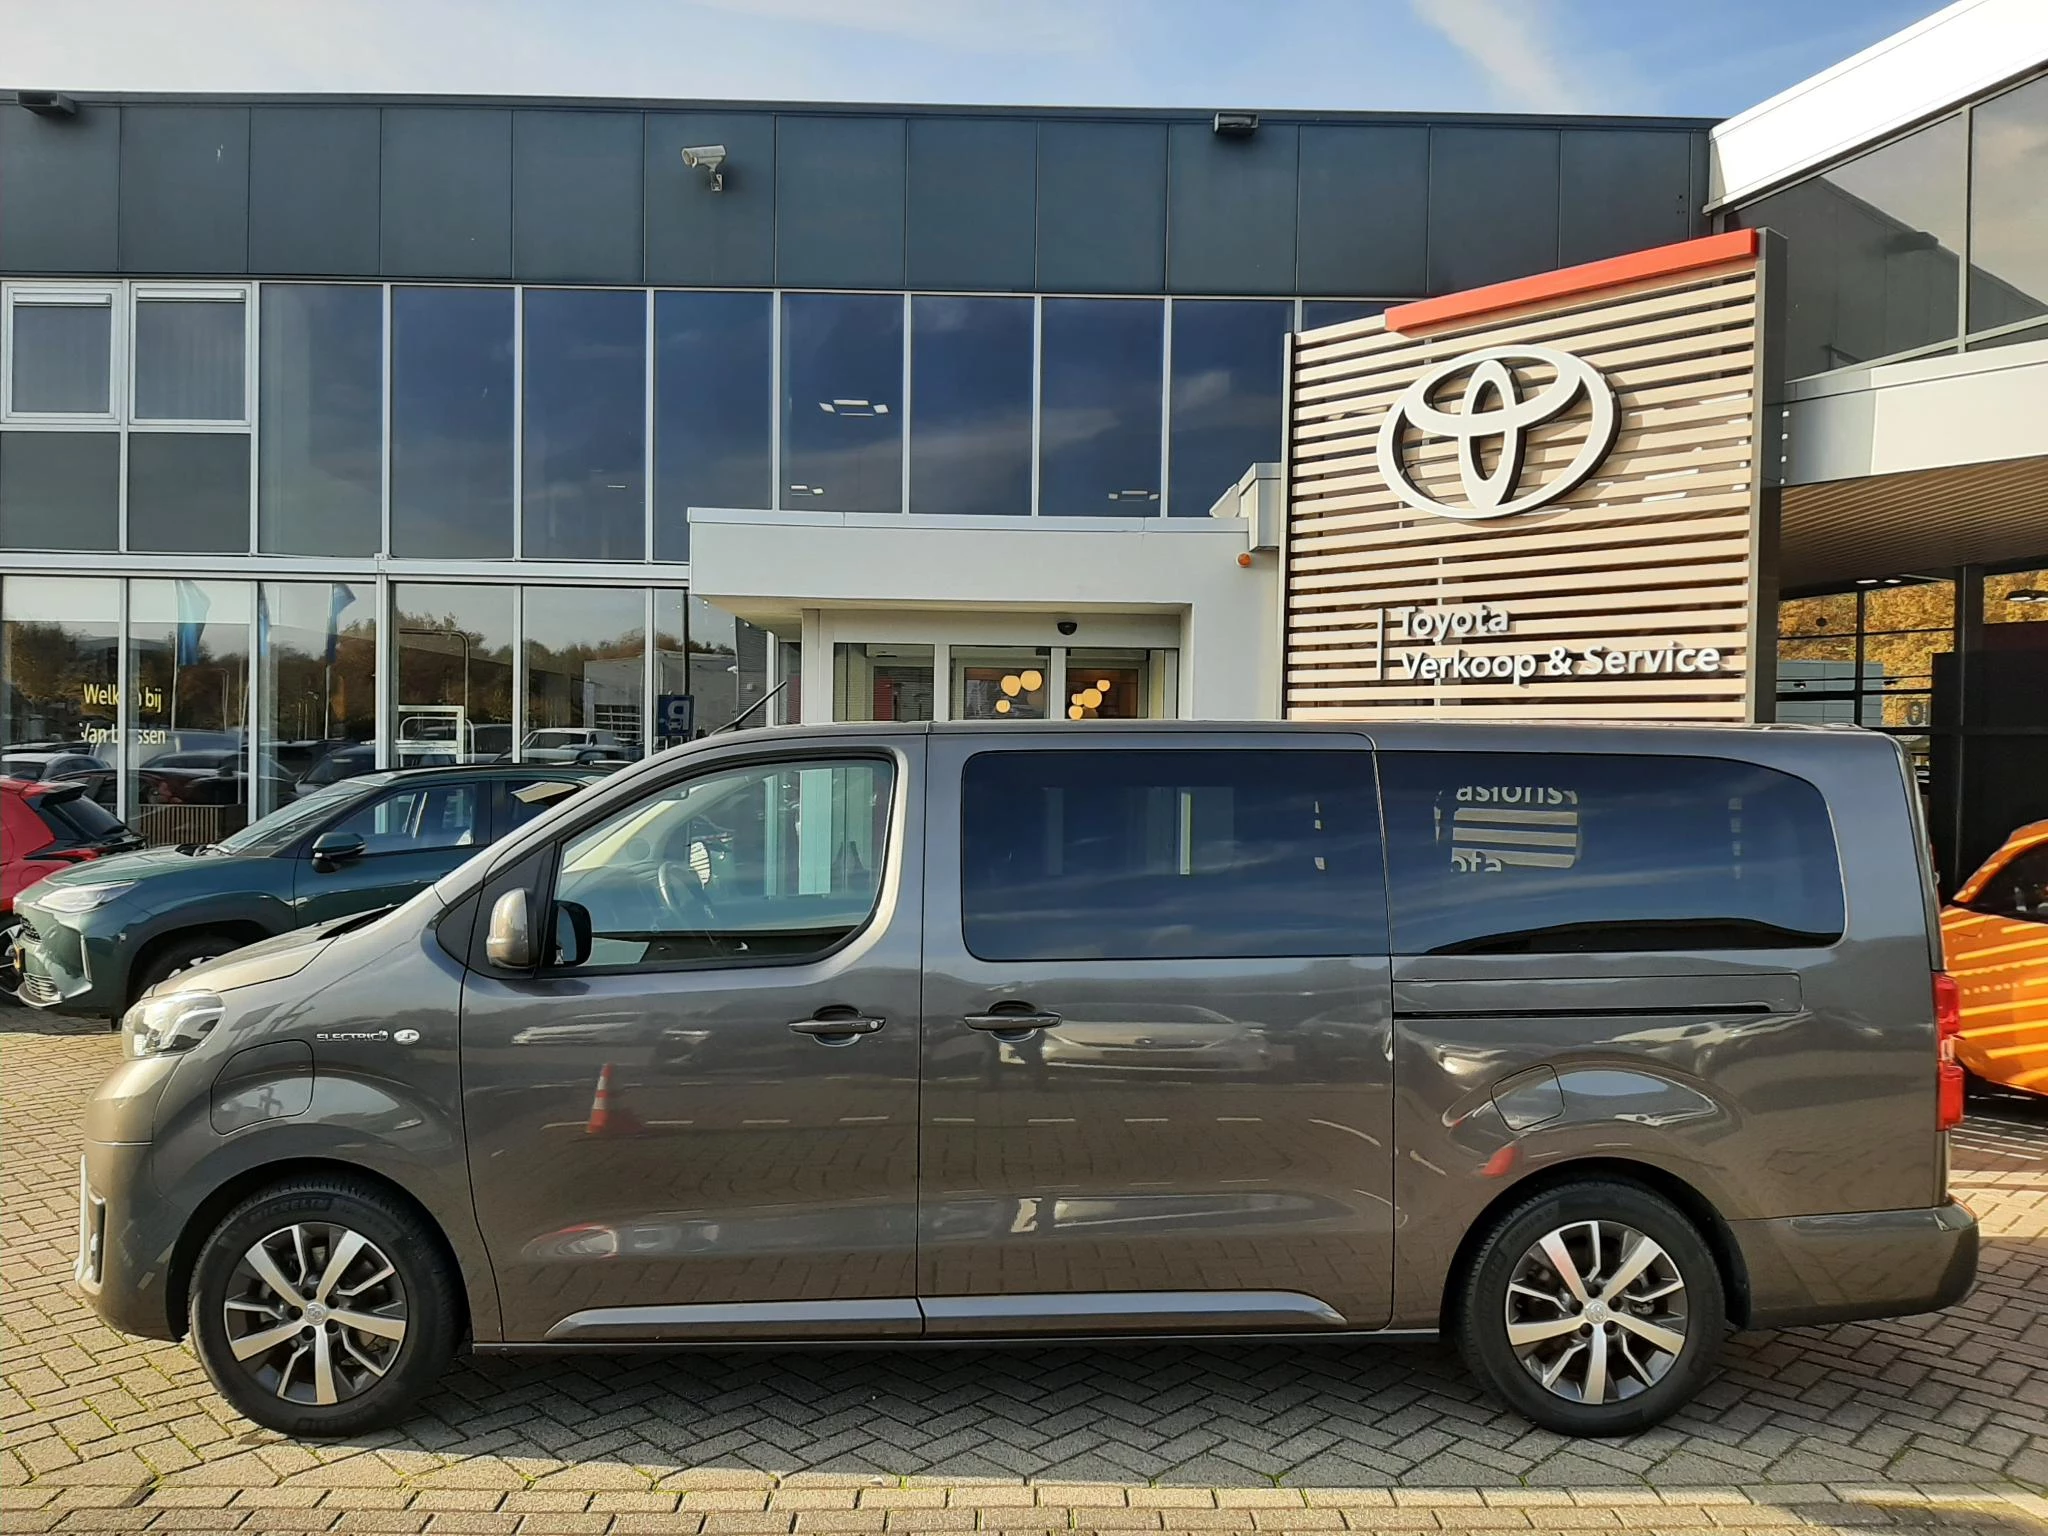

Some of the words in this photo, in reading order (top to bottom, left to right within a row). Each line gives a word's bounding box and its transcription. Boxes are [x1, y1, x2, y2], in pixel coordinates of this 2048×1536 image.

[1401, 605, 1509, 642] Toyota
[1401, 650, 1537, 685] Verkoop
[1549, 646, 1574, 676] &
[1584, 641, 1721, 675] Service
[84, 683, 142, 706] Welk
[145, 687, 162, 713] bij
[79, 722, 107, 744] Van
[112, 724, 166, 744] Lssen
